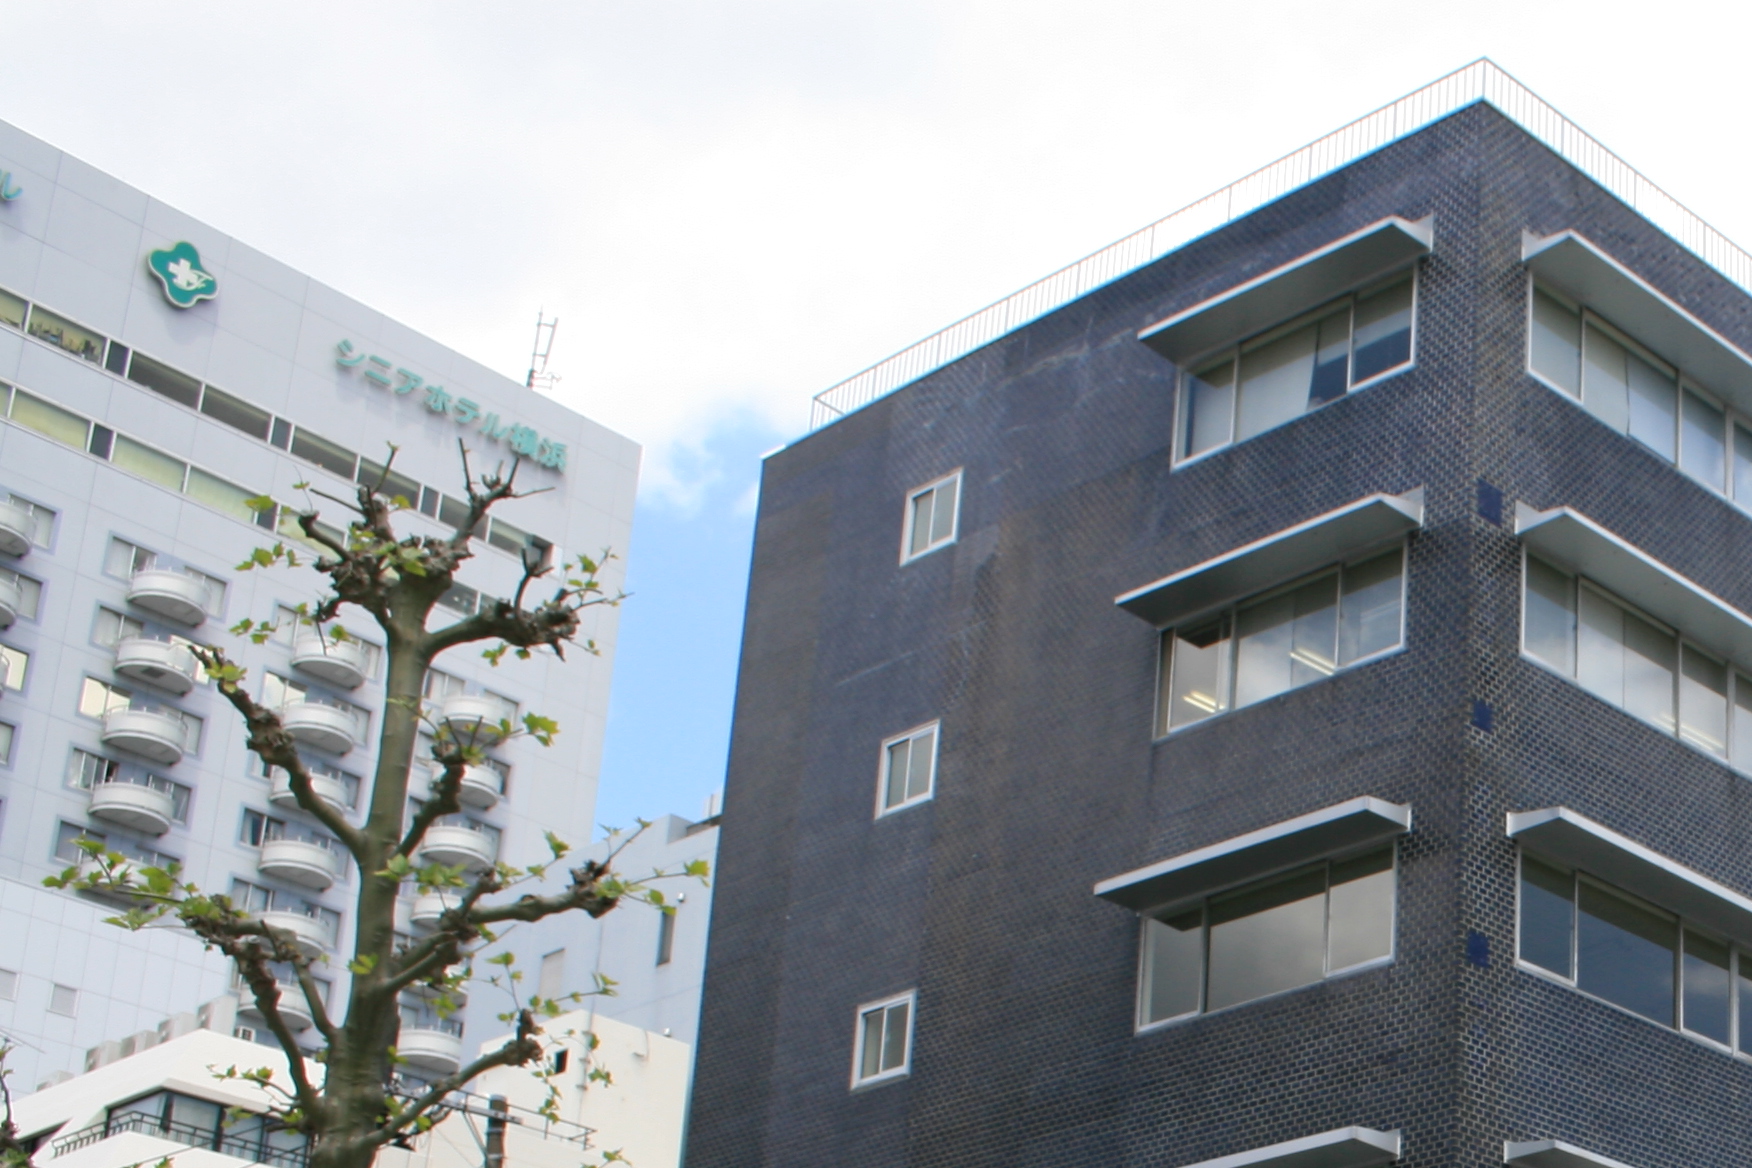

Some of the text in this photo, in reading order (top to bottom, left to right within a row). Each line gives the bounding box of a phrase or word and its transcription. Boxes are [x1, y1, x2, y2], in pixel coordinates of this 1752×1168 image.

[335, 338, 568, 474] シニアホテル横浜
